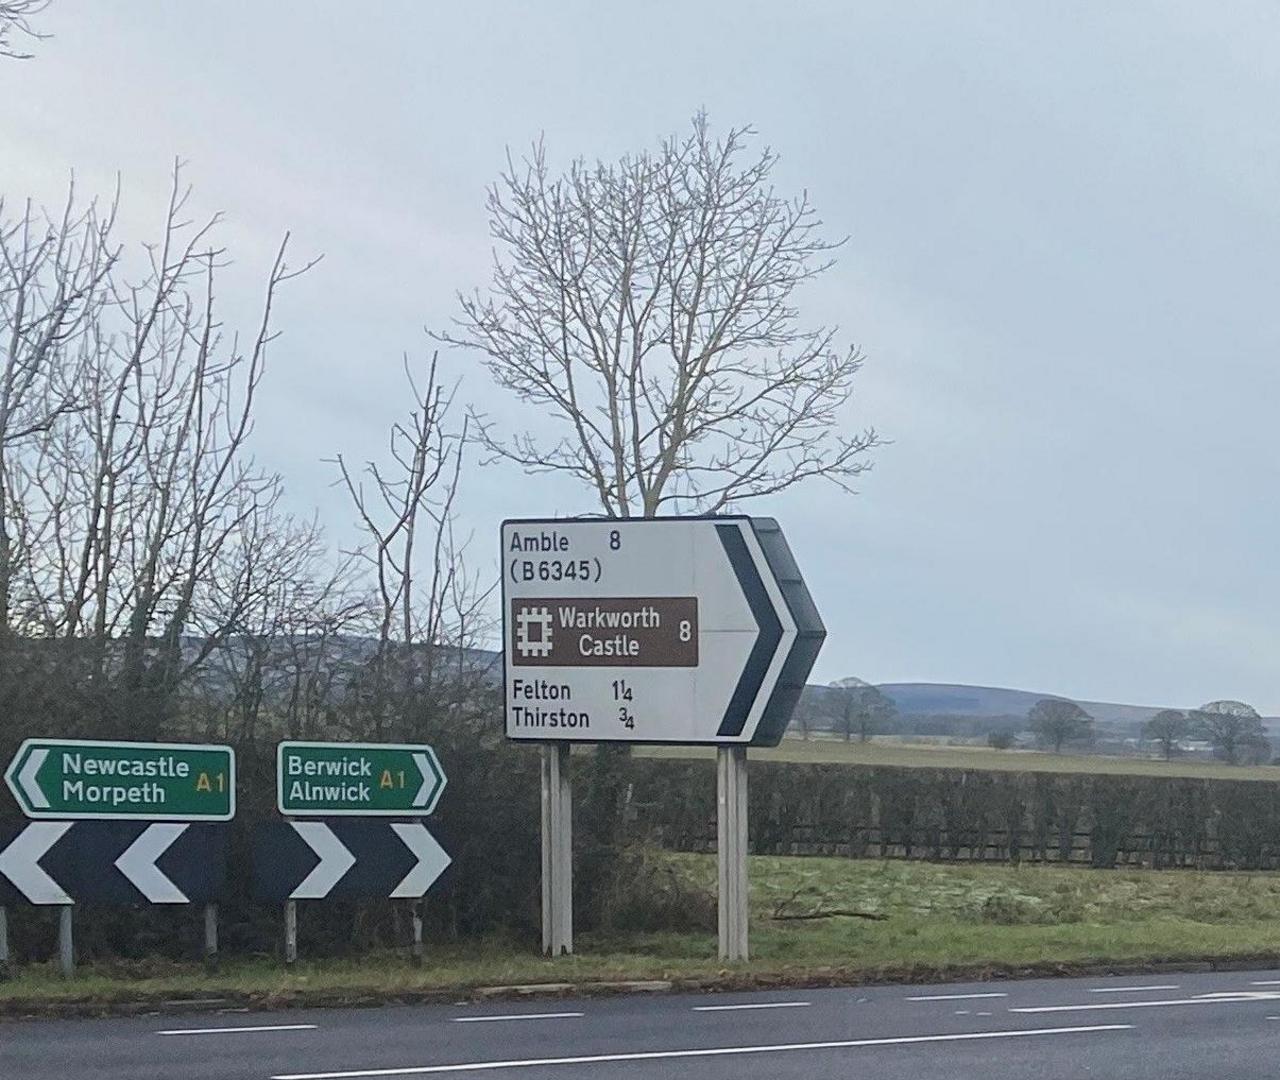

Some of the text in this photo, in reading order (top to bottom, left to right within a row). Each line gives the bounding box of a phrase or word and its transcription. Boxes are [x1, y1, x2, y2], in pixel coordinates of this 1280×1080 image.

[510, 530, 621, 552] Amble 8
[558, 606, 660, 628] Warkworth
[679, 620, 691, 641] 8
[579, 633, 640, 656] Castle
[513, 679, 571, 700] Felton
[512, 706, 590, 728] Thirston
[62, 752, 190, 778] Newcastle
[288, 755, 372, 777] Berwick
[62, 780, 166, 806] Morpeth
[289, 780, 371, 801] Alnwick
